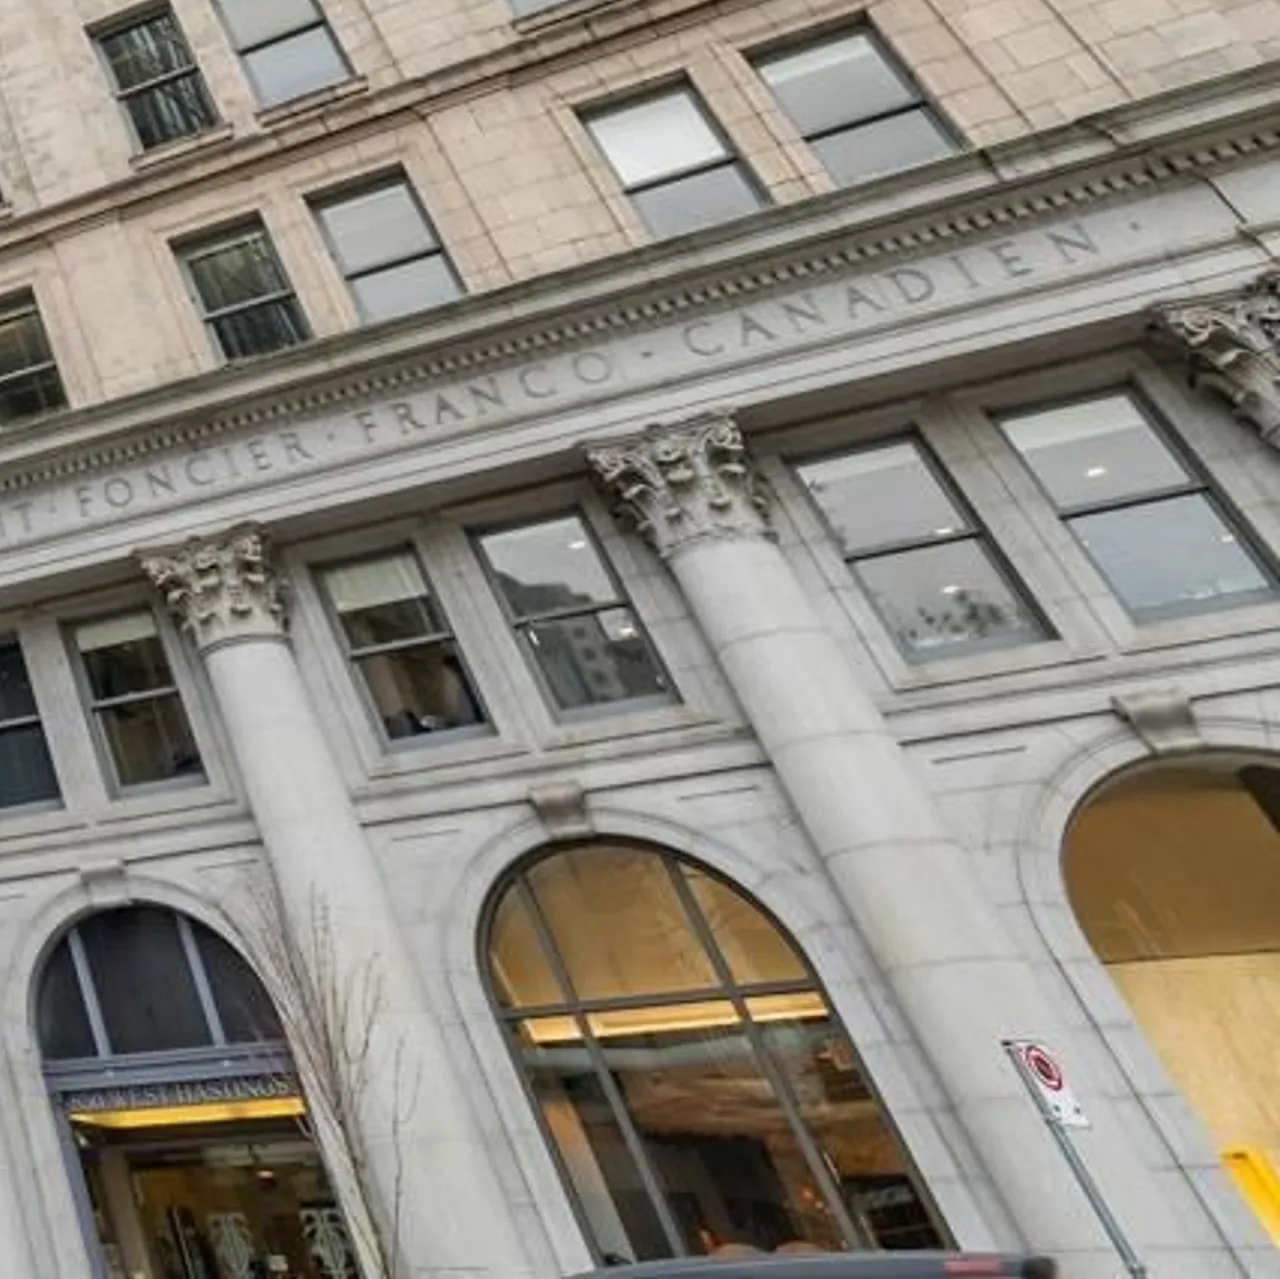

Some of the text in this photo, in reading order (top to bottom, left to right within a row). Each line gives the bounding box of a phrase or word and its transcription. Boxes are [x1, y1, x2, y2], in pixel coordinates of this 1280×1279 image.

[73, 431, 317, 518] FONCIER
[352, 349, 614, 444] FRANCO
[682, 220, 1107, 357] CANADIEN
